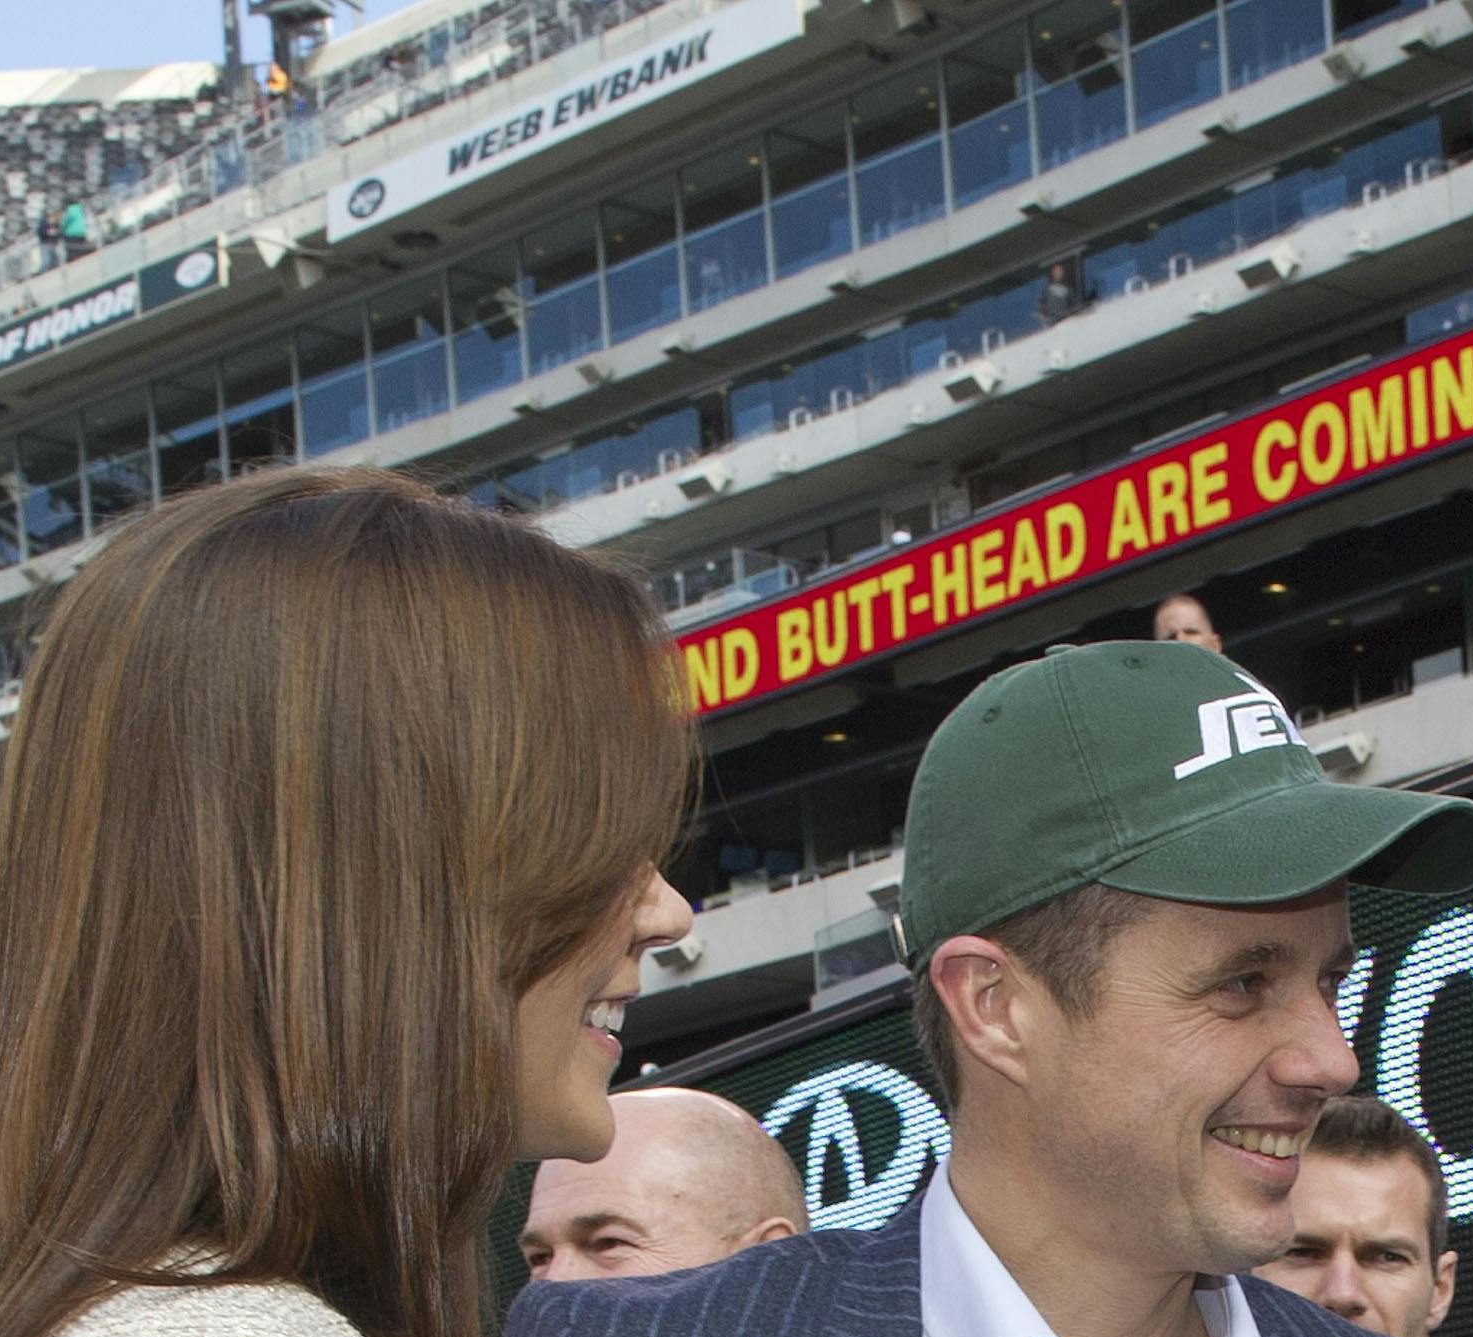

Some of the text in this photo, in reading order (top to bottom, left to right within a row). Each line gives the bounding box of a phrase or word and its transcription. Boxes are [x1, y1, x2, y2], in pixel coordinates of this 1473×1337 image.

[447, 29, 713, 176] WEEB EWBANK
[26, 282, 139, 352] HONOR
[681, 626, 759, 710] ND
[777, 502, 1087, 683] BUTT-HEAD
[1106, 442, 1232, 560] ARE
